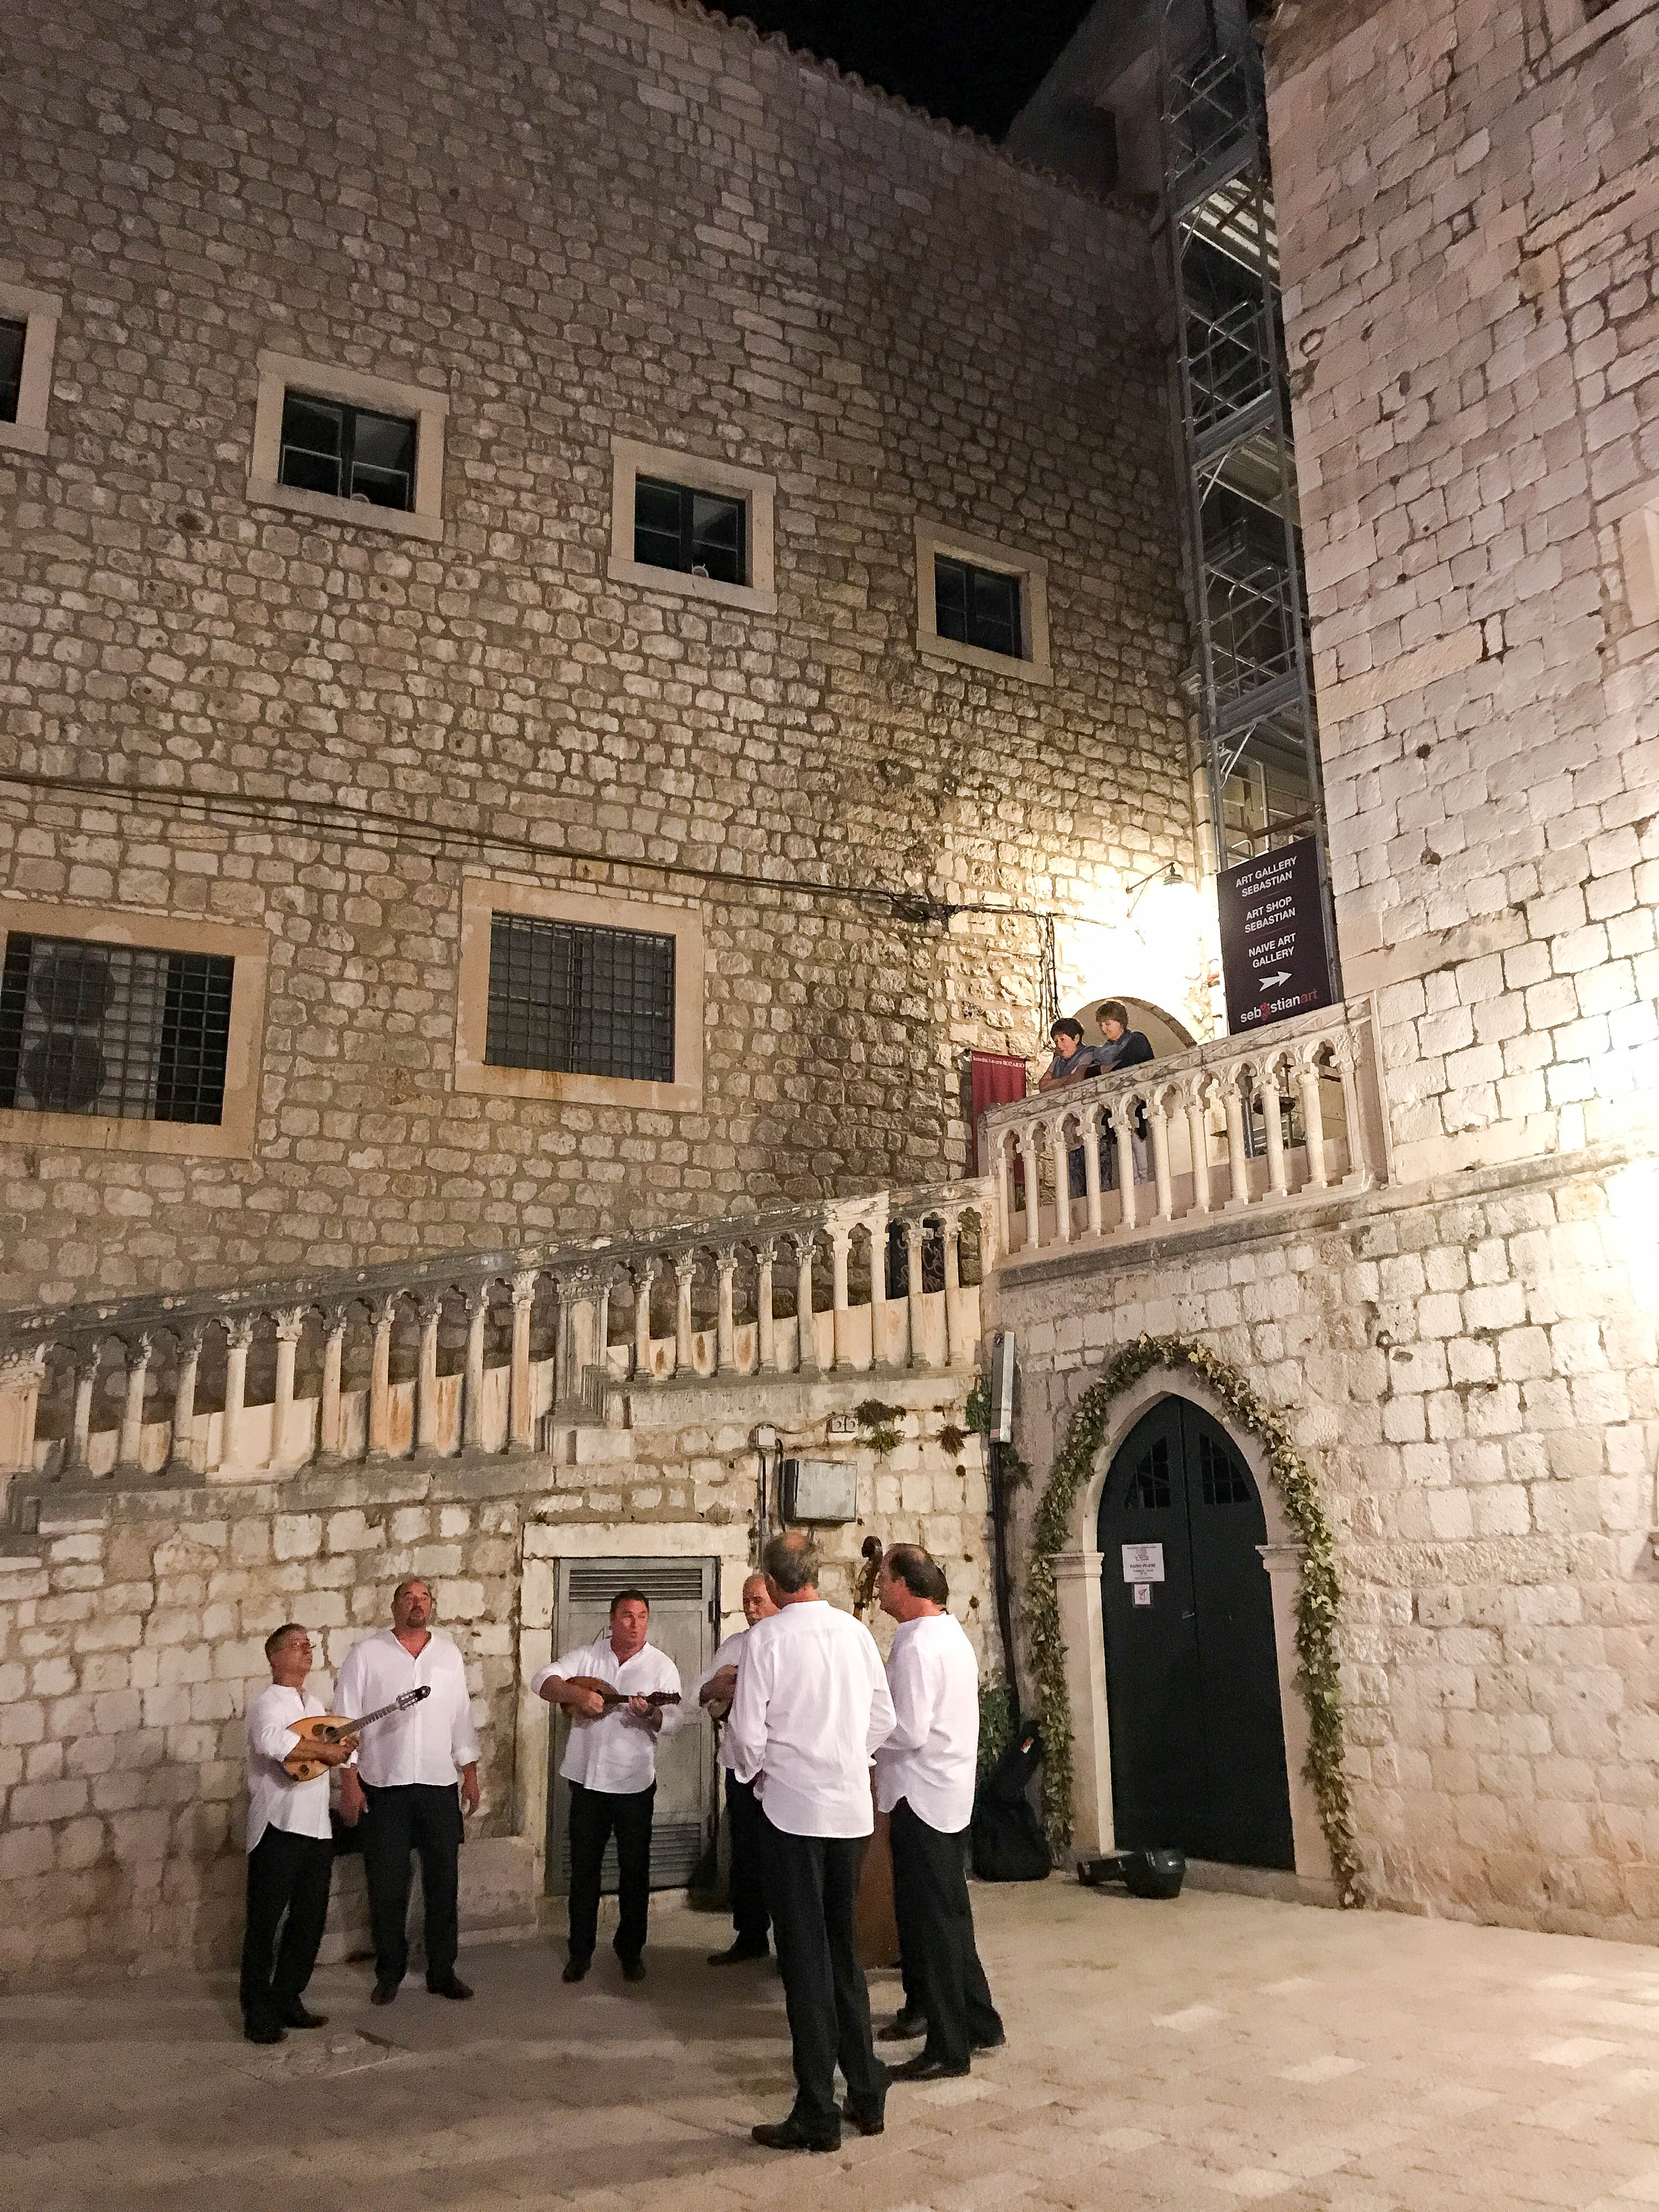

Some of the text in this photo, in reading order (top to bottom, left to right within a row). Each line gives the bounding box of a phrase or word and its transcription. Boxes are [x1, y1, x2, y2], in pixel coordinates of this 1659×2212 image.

[1235, 855, 1298, 888] ART GALLERY
[1242, 870, 1293, 897] SEBASTIAN
[1244, 907, 1296, 933] SEBASTIAN
[1246, 896, 1292, 921] ART SHOP
[1248, 932, 1296, 957] NAIVE ART
[1252, 946, 1295, 968] GALLERY
